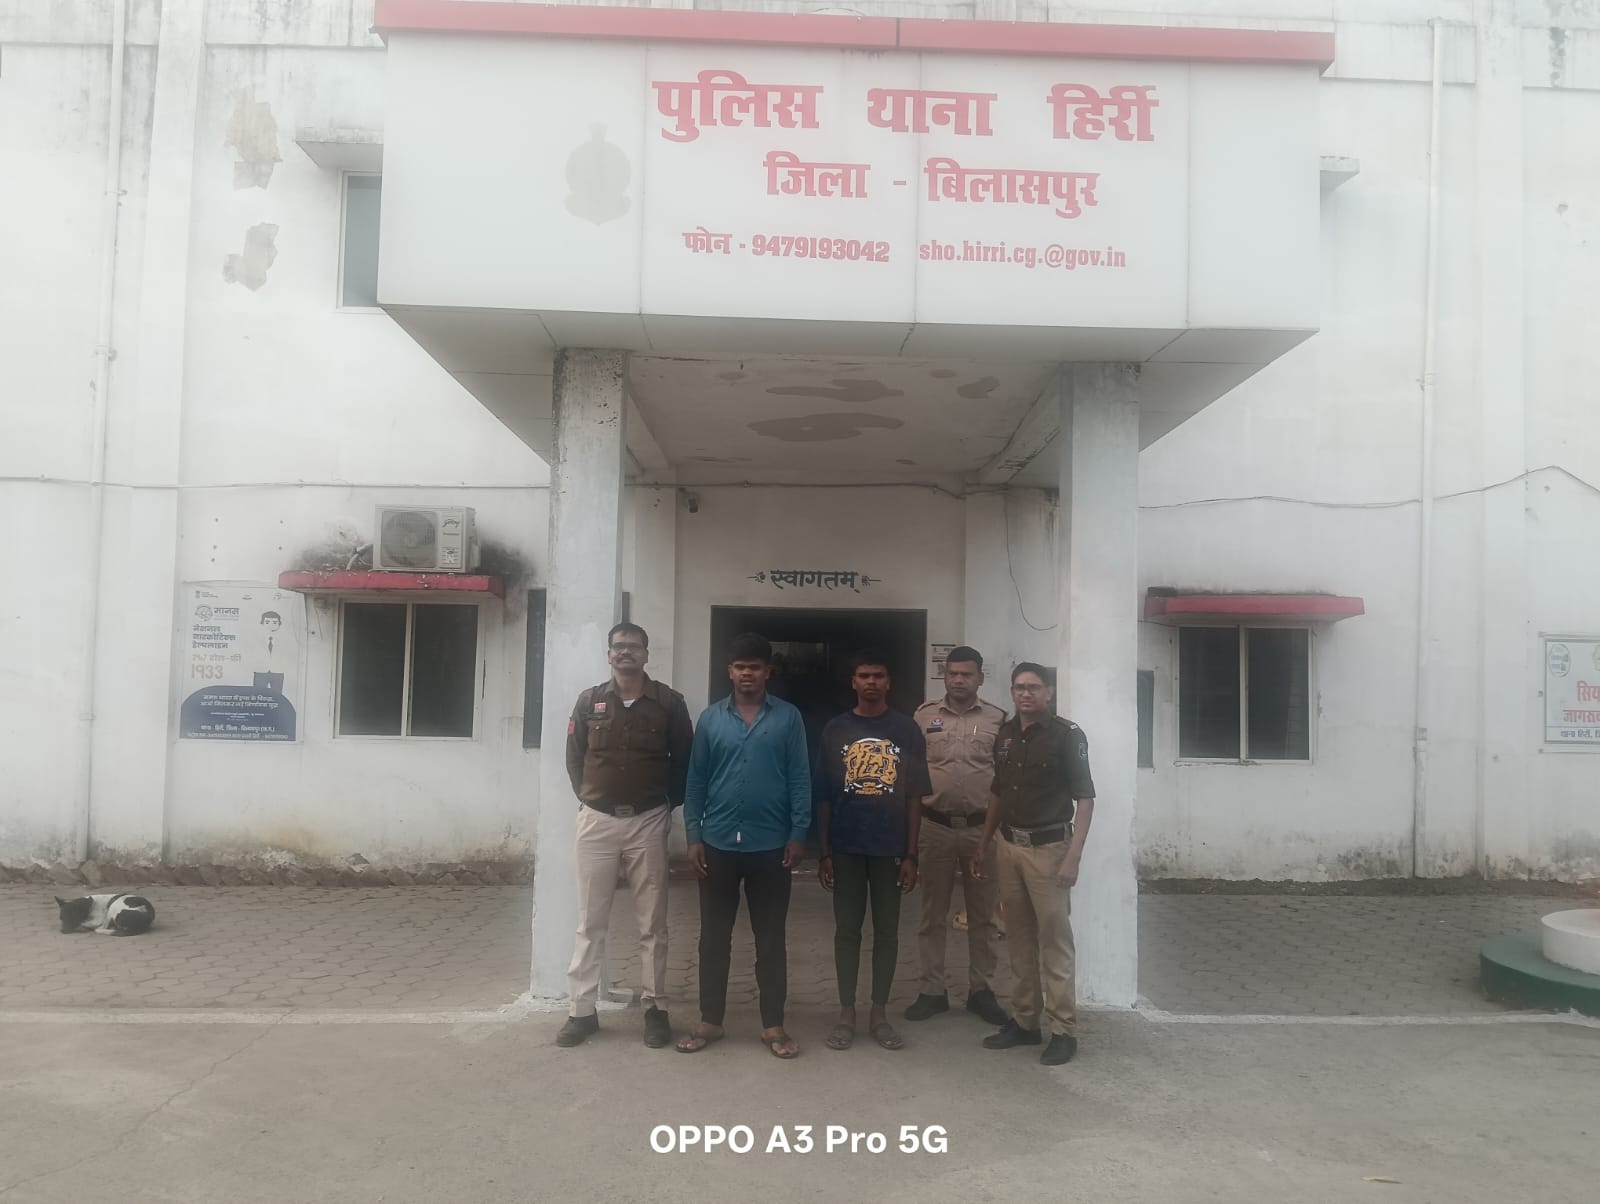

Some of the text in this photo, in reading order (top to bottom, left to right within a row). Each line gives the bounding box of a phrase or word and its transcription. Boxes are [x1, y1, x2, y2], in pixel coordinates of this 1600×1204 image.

[651, 69, 1160, 143] पुलिस थाना हिर्री
[762, 150, 871, 199] जिला
[923, 157, 1101, 219] बिलासपुर
[682, 226, 733, 255] फोन
[752, 234, 890, 263] 9479193042
[919, 239, 1126, 271] sho.hirri.cg.@gov.in
[770, 569, 861, 594] स्वागतम्
[191, 663, 224, 680] 1933
